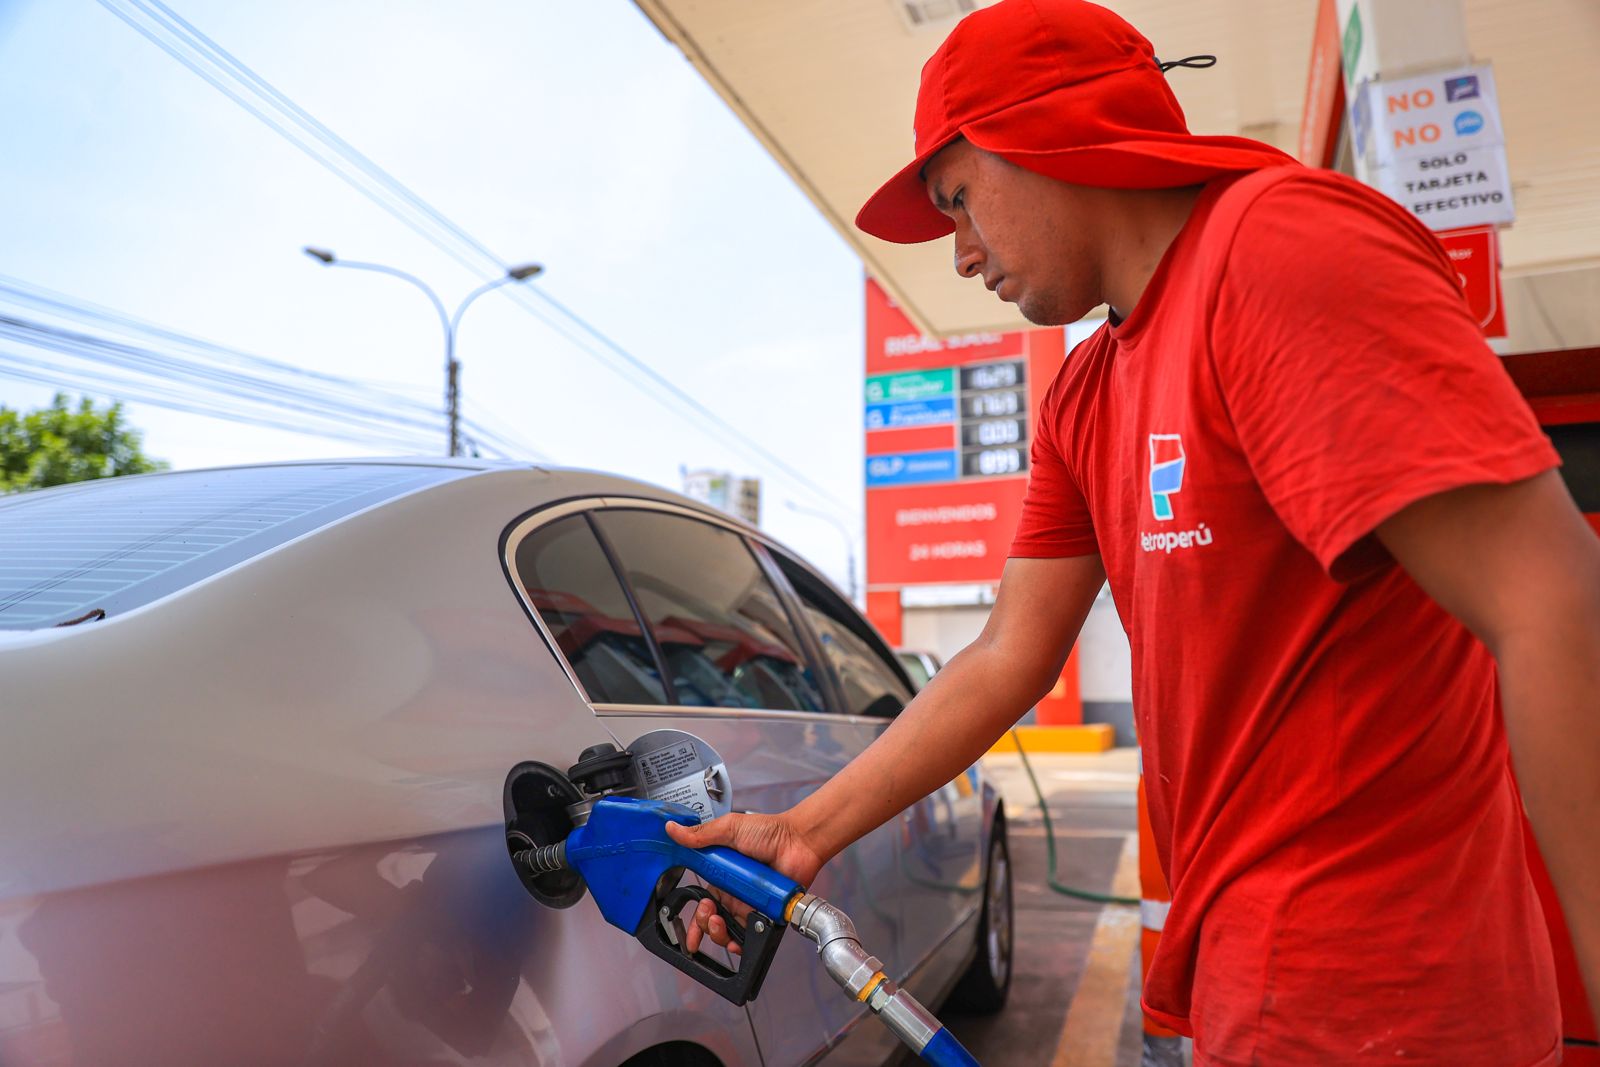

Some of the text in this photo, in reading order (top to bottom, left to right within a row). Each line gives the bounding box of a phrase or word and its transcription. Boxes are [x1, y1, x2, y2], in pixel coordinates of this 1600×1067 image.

[1388, 89, 1435, 113] NO
[1394, 124, 1441, 148] NO
[1419, 153, 1467, 171] SOLO
[1406, 170, 1489, 193] TARJETA
[1414, 192, 1504, 215] EFECTIVO
[931, 540, 987, 559] HORAS
[1141, 523, 1213, 554] etroperú
